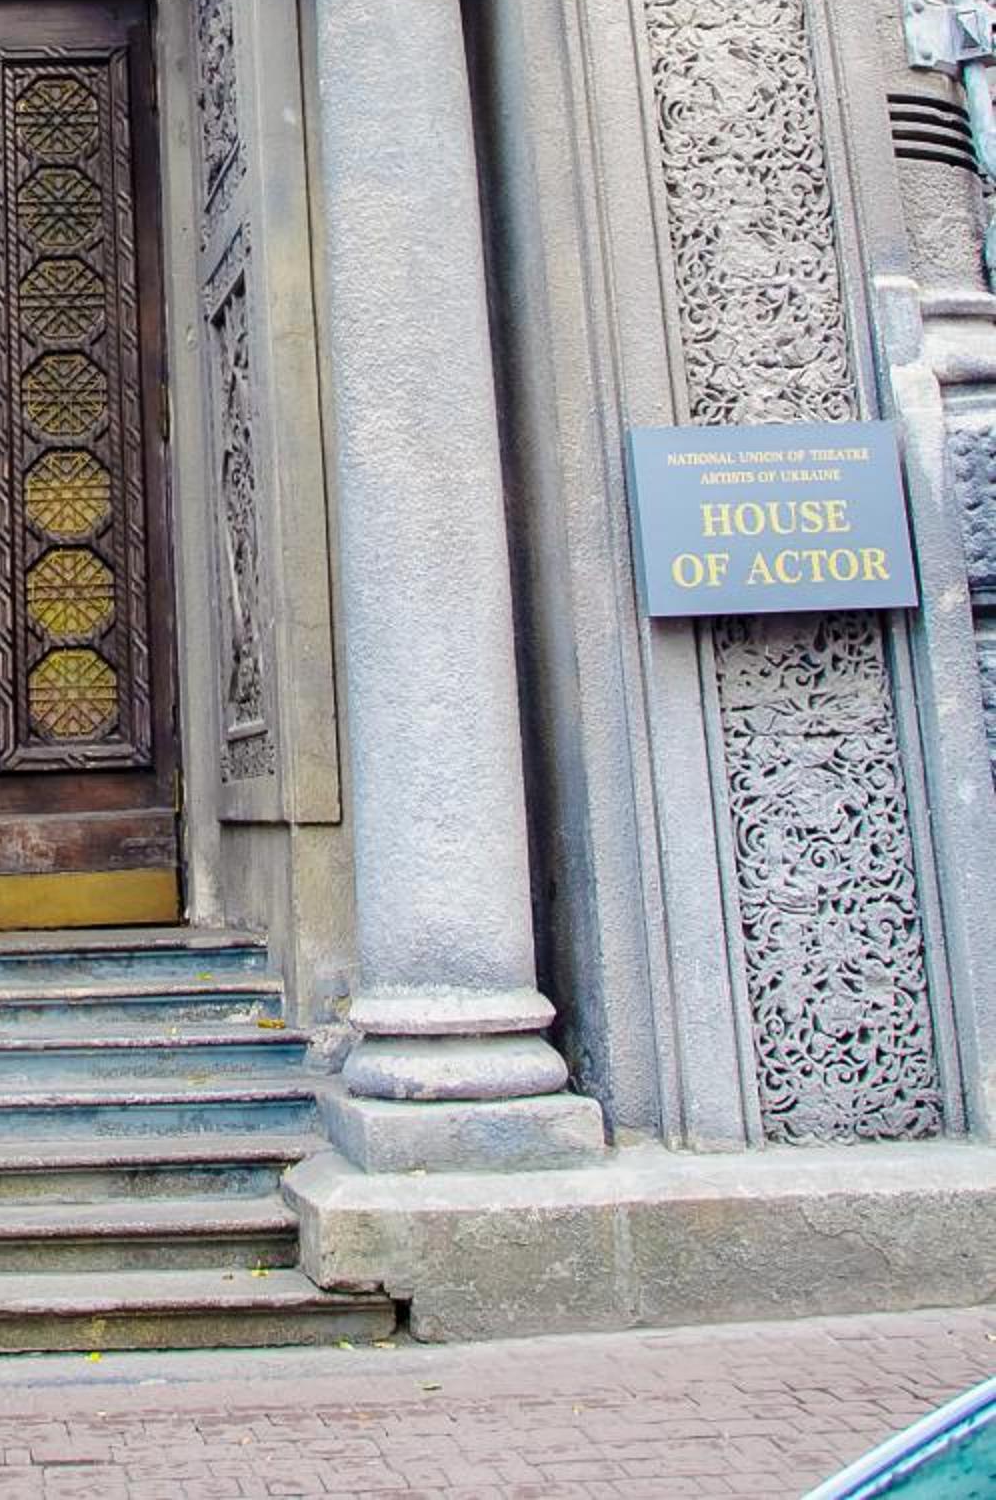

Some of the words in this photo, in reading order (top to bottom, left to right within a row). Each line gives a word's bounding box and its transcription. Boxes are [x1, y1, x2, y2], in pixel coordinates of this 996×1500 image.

[668, 451, 735, 466] NATIONAL
[739, 450, 783, 465] UNION
[787, 449, 805, 463] OF
[811, 448, 870, 462] THEATRE
[700, 470, 754, 485] ARTISTS
[758, 470, 777, 484] OF
[781, 468, 842, 482] UKRAINE
[700, 499, 852, 538] HOUSE
[671, 553, 729, 589] OF
[747, 547, 890, 585] ACTOR
